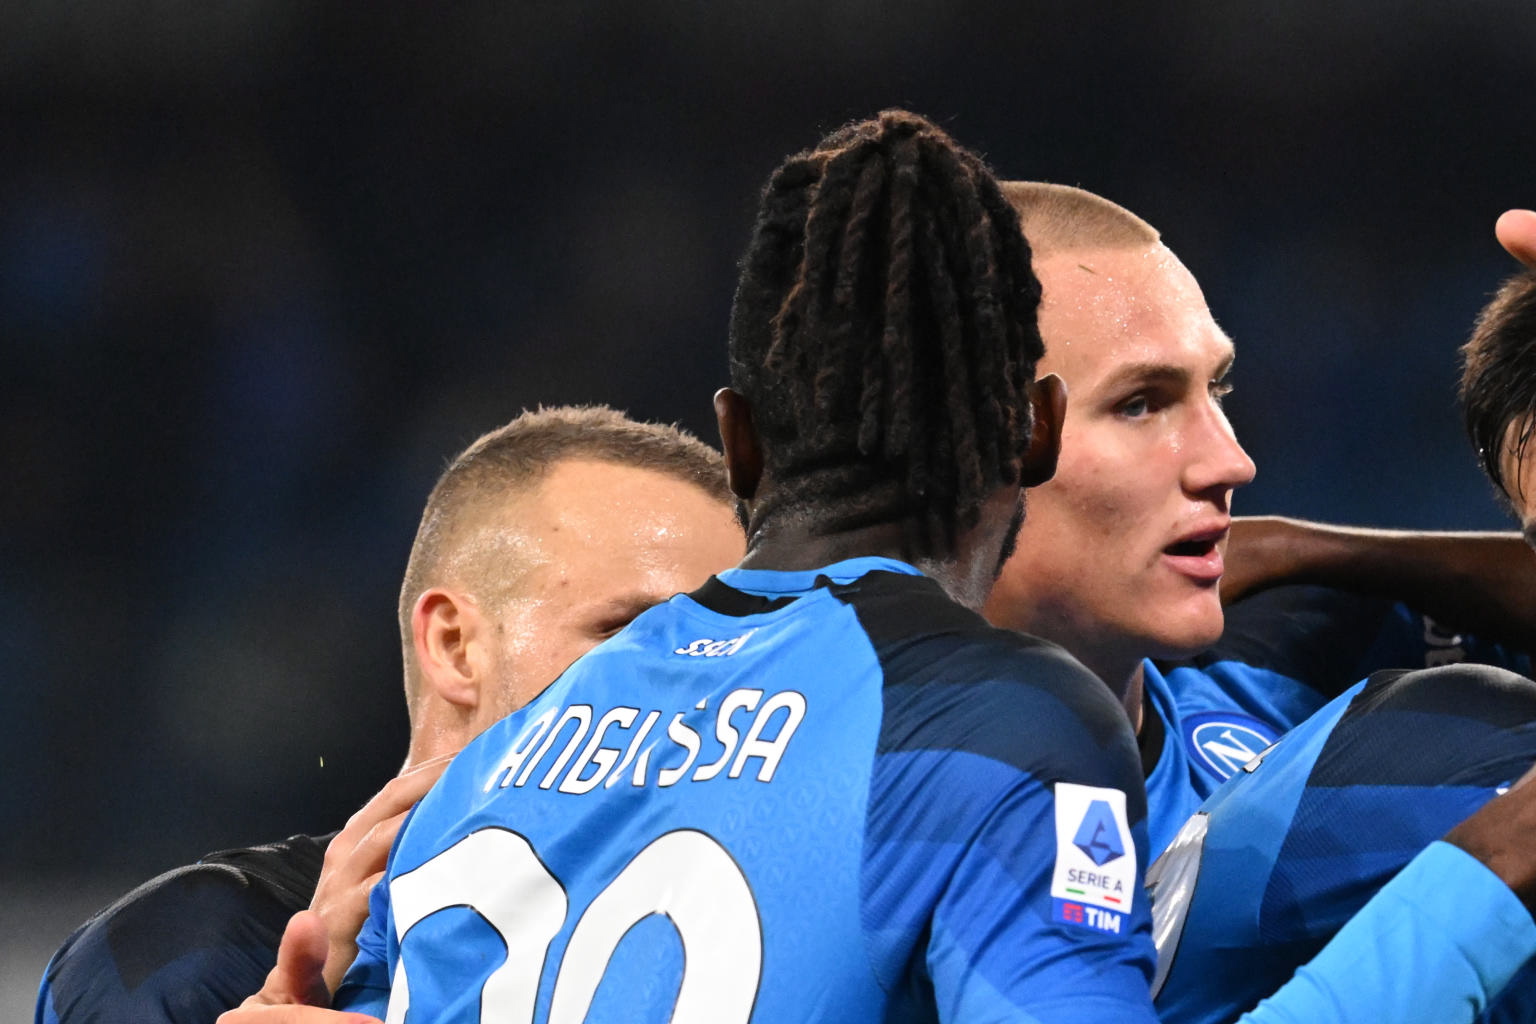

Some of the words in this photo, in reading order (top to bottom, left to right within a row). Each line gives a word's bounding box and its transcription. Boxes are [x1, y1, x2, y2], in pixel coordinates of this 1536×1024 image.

[1067, 868, 1109, 889] SERIE
[1113, 879, 1124, 893] A
[1085, 907, 1122, 934] TIM
